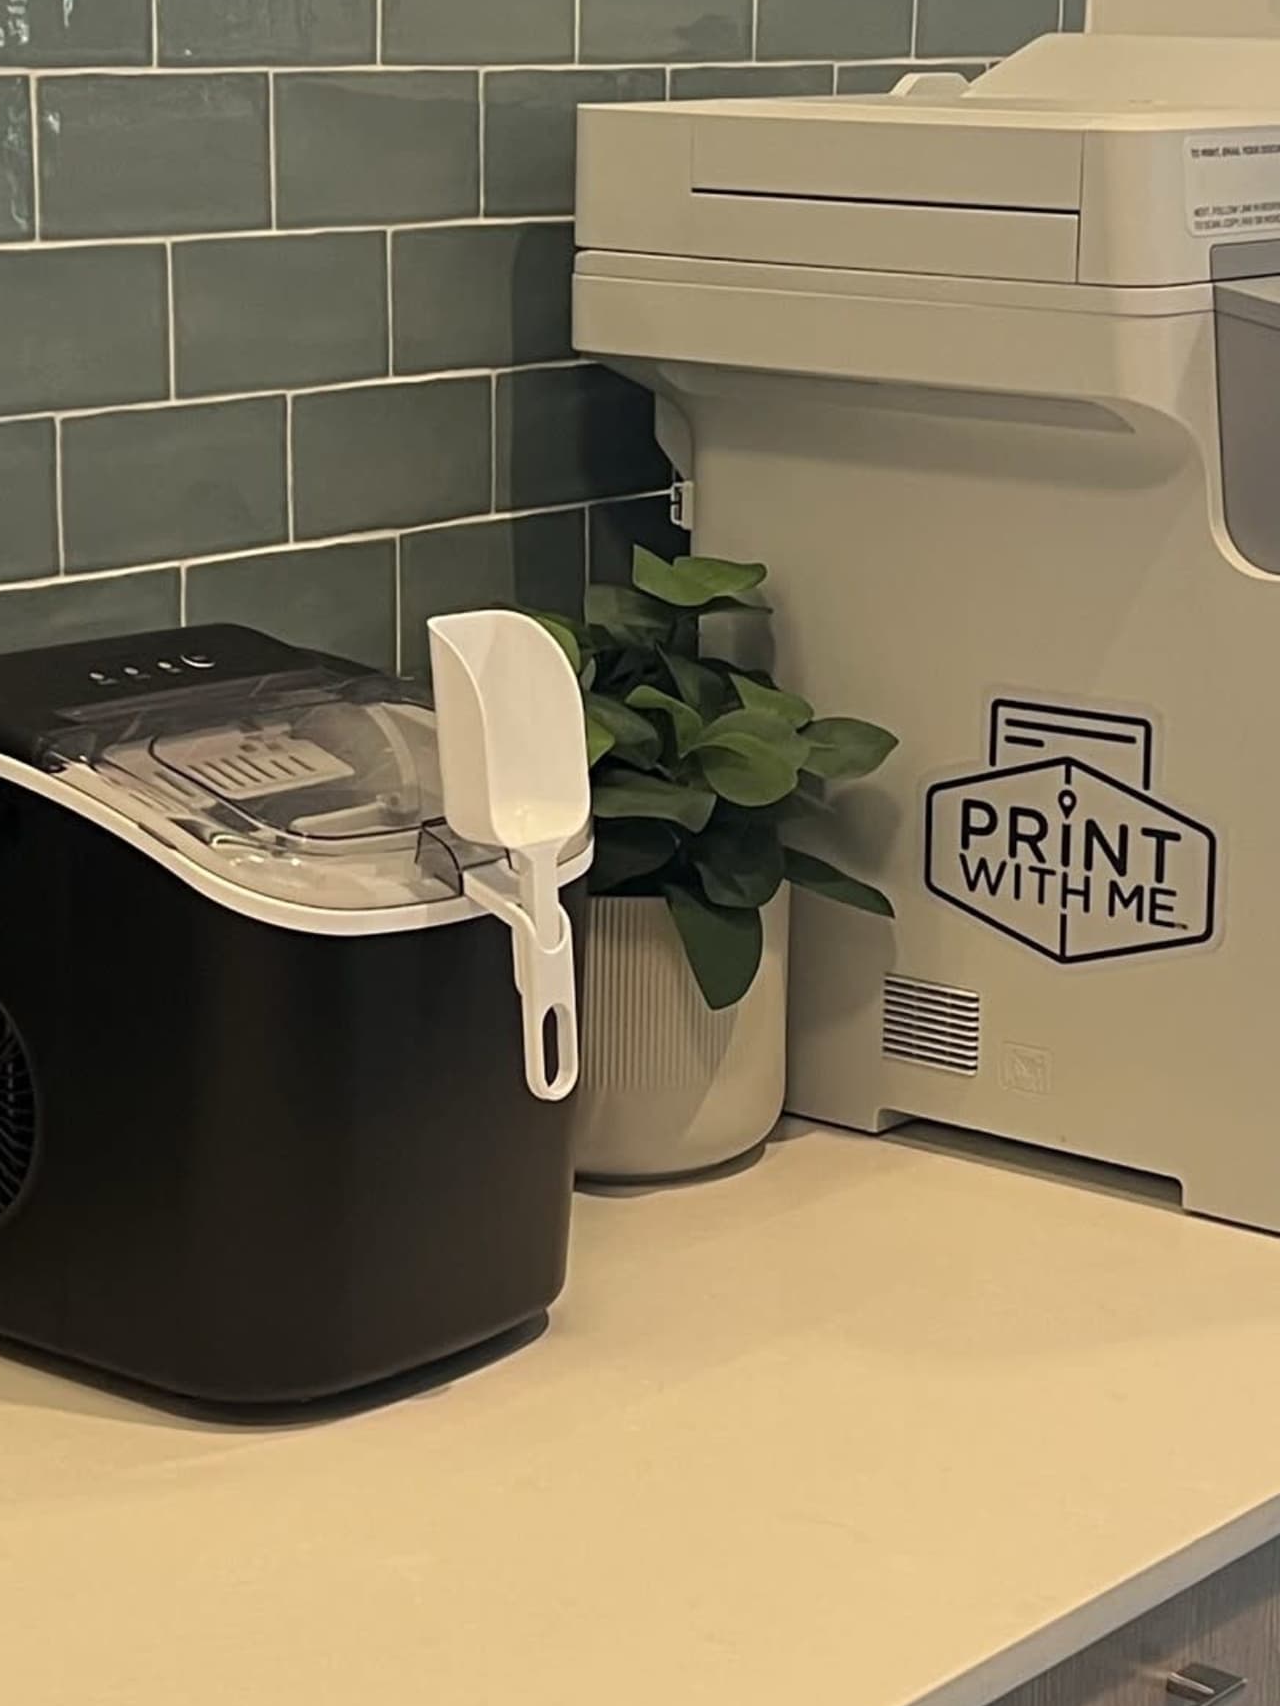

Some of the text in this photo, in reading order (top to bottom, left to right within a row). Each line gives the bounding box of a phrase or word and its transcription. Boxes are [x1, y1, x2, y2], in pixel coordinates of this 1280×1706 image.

[961, 792, 1182, 885] PRINT
[959, 852, 1178, 928] WITH ME
